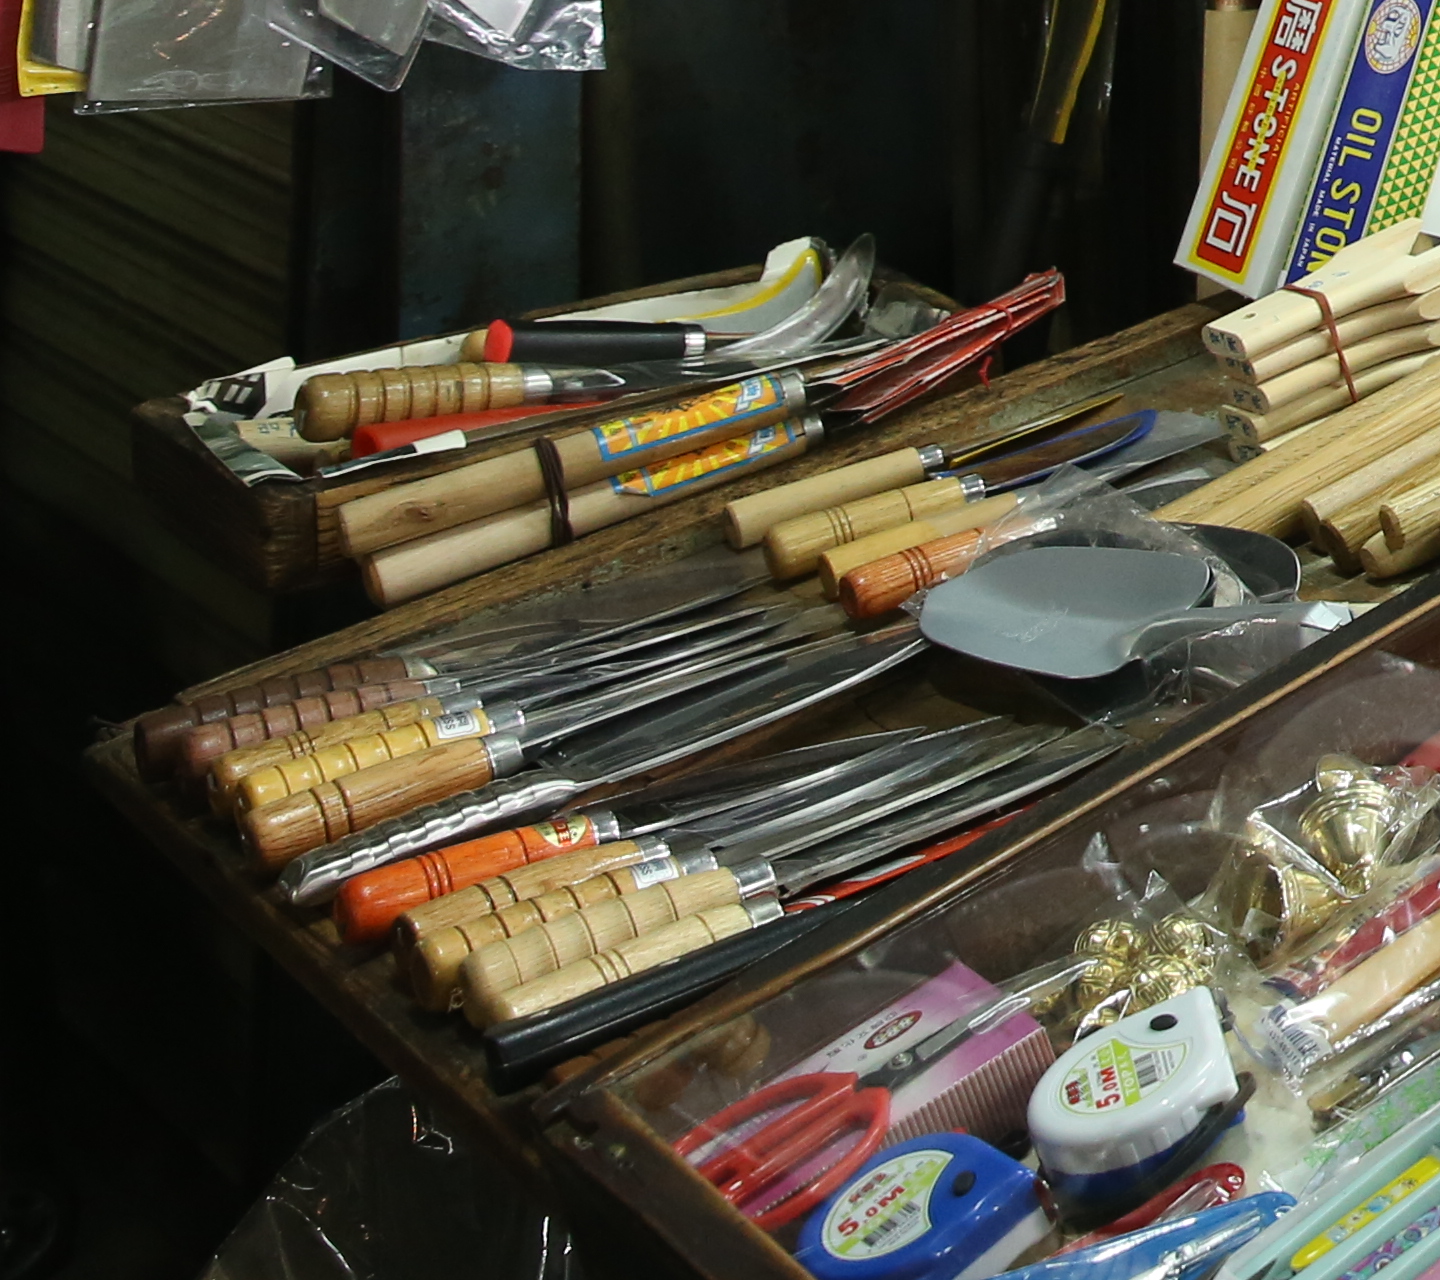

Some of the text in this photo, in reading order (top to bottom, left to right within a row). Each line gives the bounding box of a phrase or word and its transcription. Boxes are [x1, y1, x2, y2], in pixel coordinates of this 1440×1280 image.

[1232, 55, 1299, 194] STONE
[1270, 81, 1301, 160] ARTIFICIAL
[1307, 107, 1383, 272] OIL STON
[1318, 136, 1343, 184] MATERIAL
[1311, 188, 1326, 218] MADE
[1295, 235, 1311, 267] JAPAN
